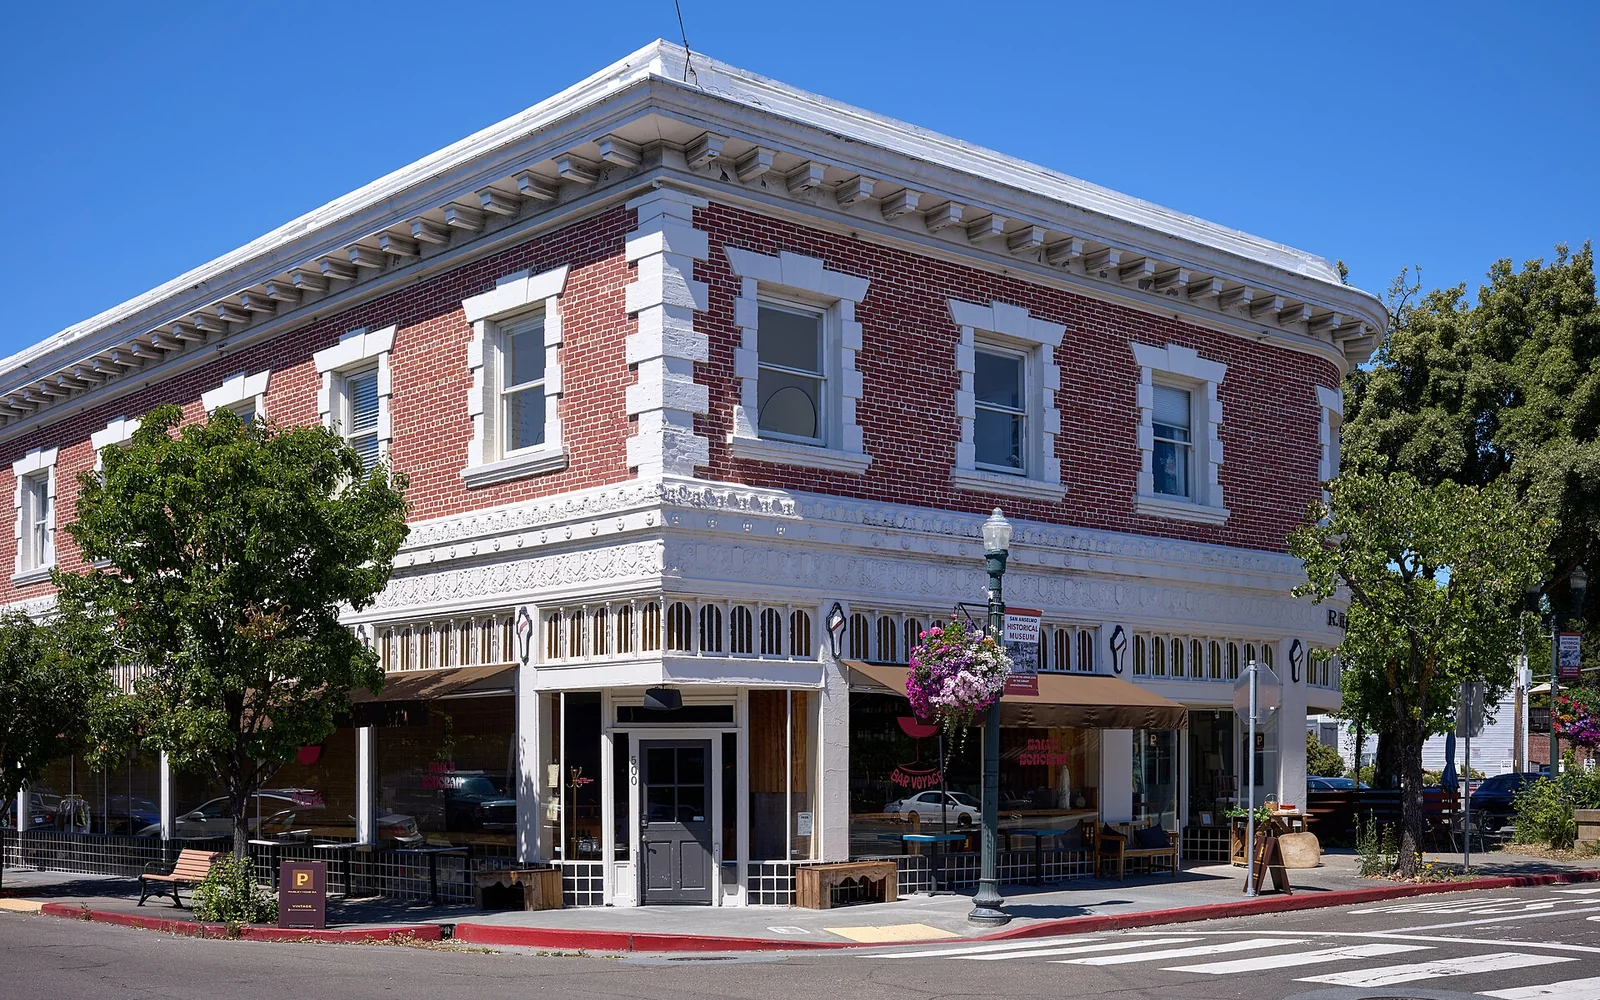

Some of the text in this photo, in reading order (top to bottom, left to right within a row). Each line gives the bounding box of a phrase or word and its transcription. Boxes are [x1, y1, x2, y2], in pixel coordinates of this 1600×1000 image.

[1006, 623, 1039, 632] HISTORICAL
[1009, 632, 1035, 640] MUSEUM
[630, 755, 638, 786] 500
[890, 768, 944, 790] BAR VOYAGE
[296, 872, 309, 886] P
